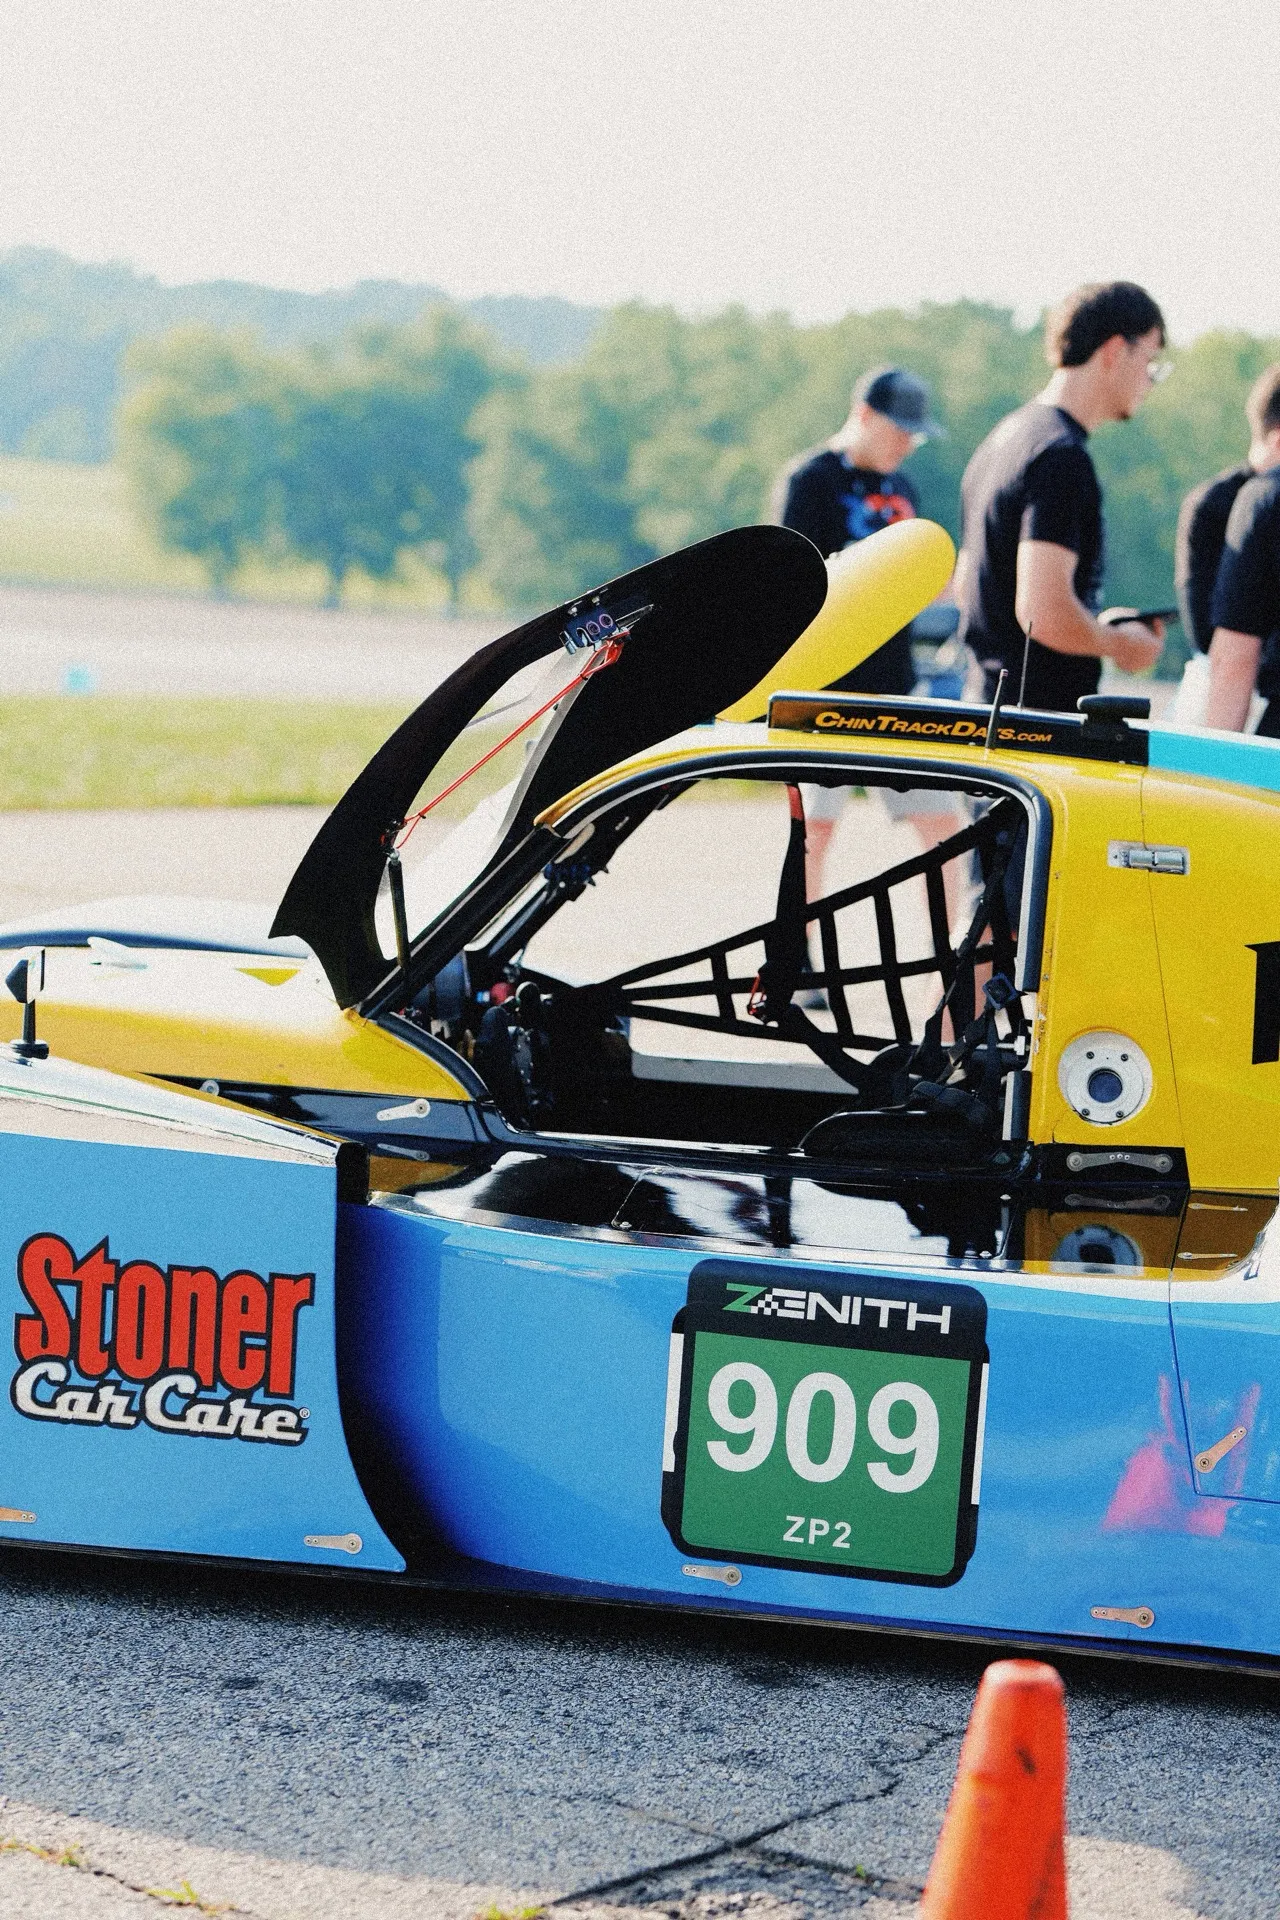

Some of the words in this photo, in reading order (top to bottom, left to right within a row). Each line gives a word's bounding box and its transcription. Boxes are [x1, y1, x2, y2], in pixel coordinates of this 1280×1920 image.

[814, 711, 1053, 742] CHINTRACKDAS.COM
[16, 1234, 314, 1397] Stoner
[722, 1282, 952, 1334] ZENITH
[12, 1359, 138, 1428] Car
[706, 1361, 940, 1494] 909
[782, 1515, 852, 1549] ZP2
